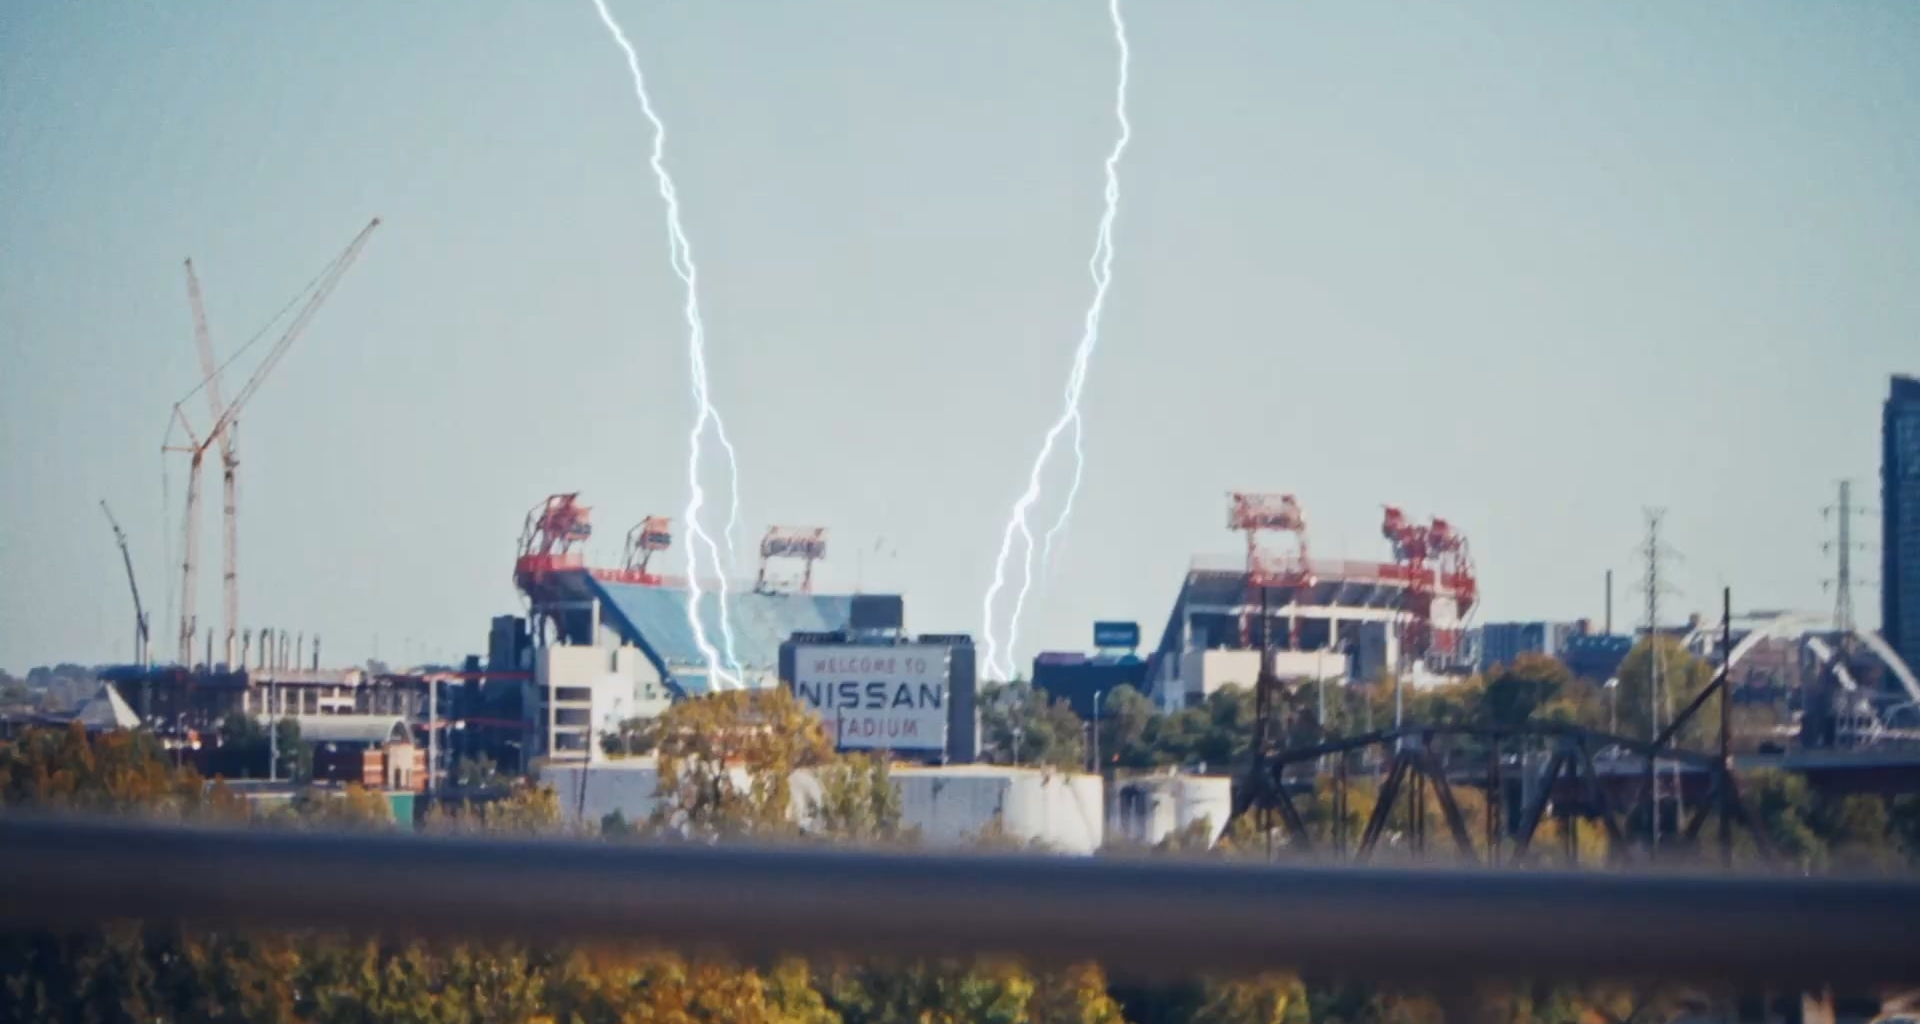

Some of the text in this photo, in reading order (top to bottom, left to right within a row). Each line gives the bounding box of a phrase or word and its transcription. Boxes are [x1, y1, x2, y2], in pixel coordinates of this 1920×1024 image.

[815, 658, 926, 674] WELCOME TO
[799, 682, 942, 709] NISSAN
